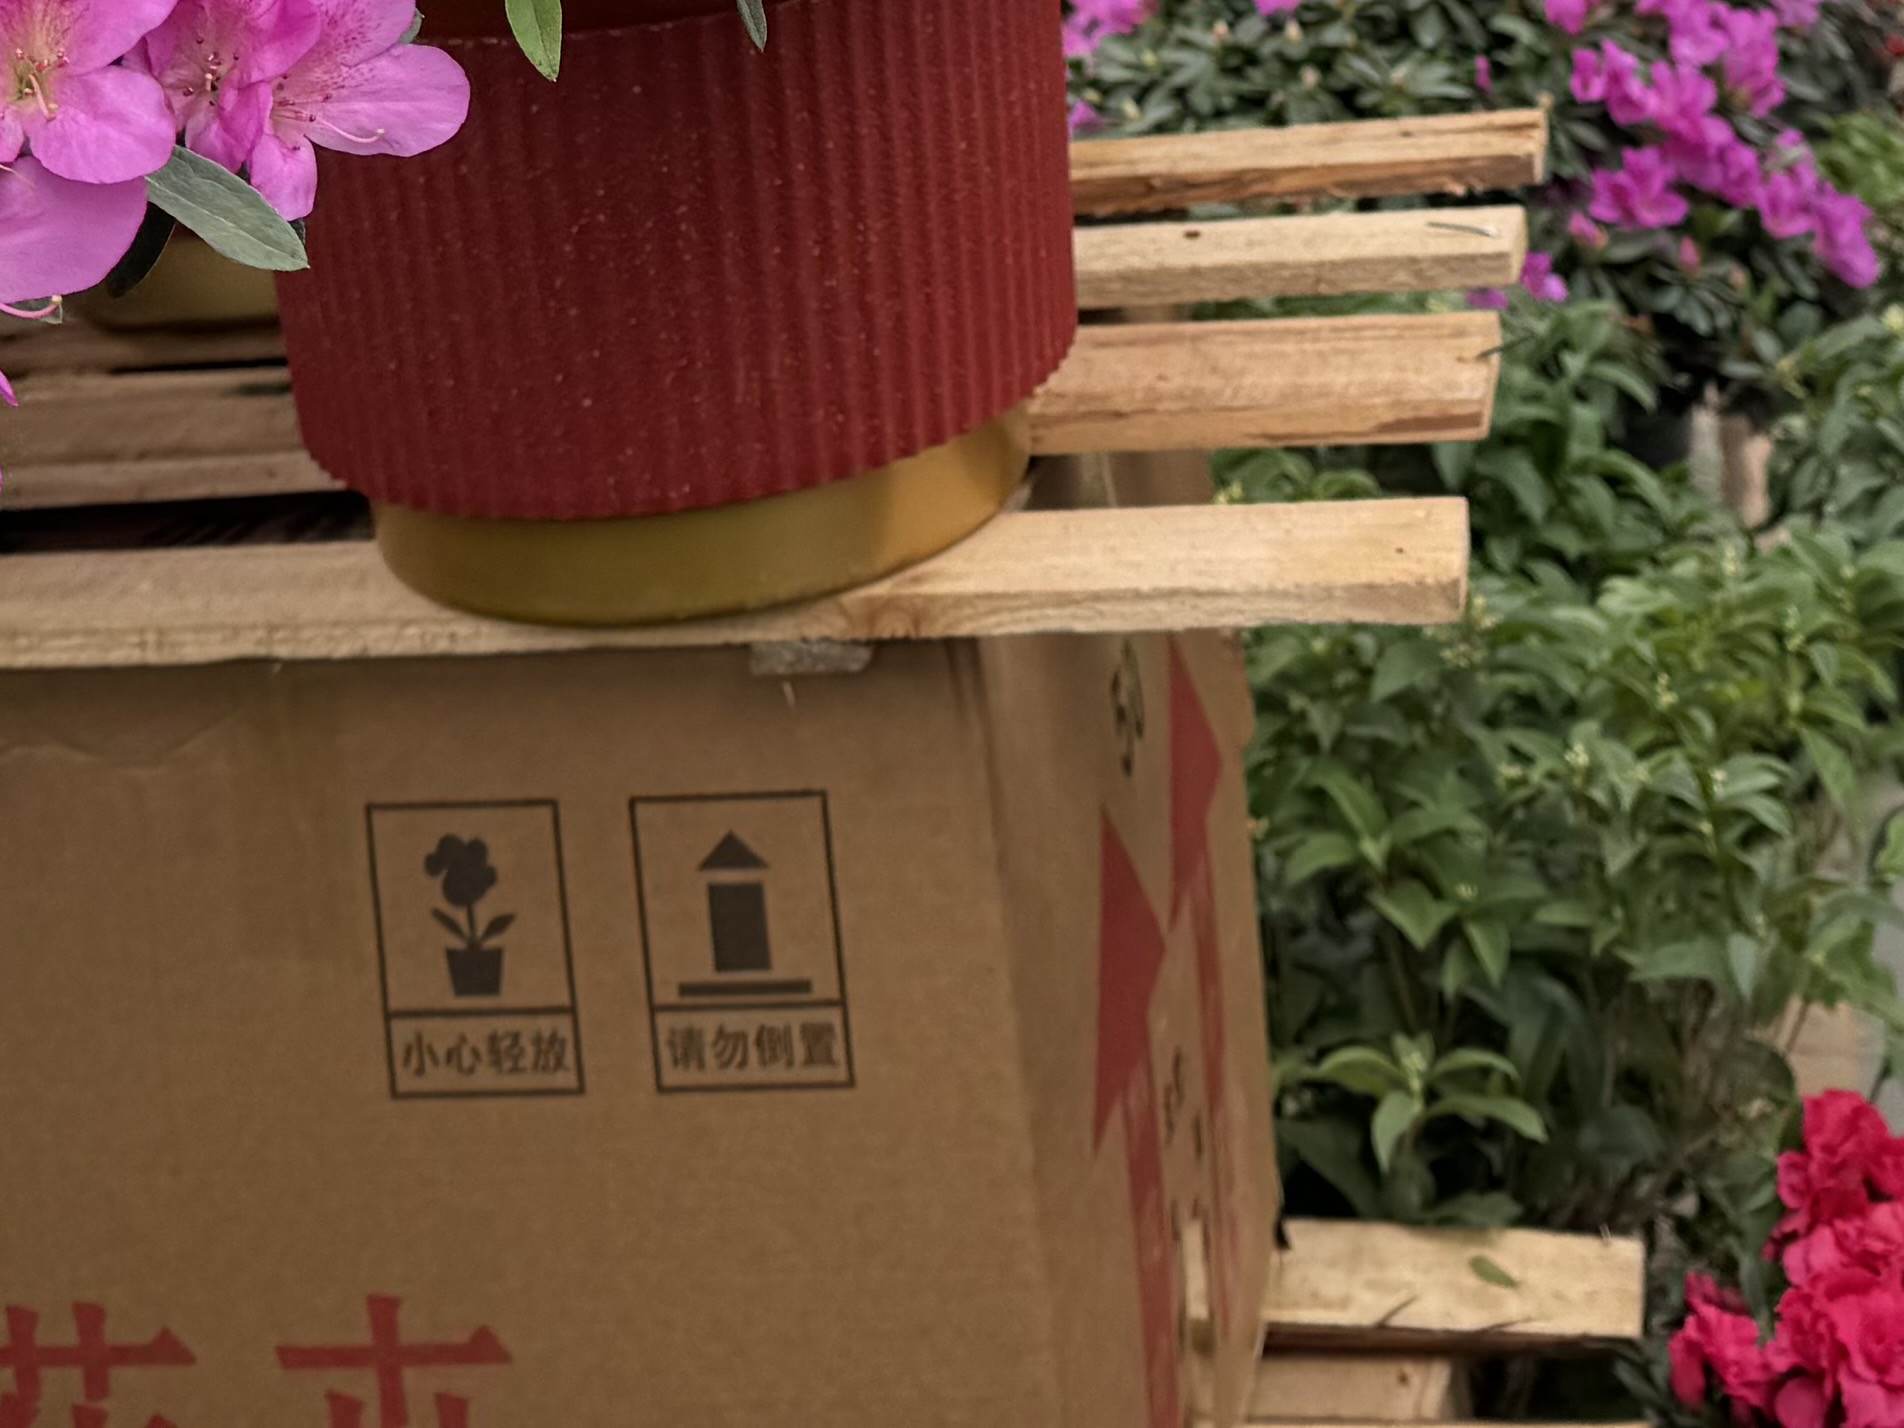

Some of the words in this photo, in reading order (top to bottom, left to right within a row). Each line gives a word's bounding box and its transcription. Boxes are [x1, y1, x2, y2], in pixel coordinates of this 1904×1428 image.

[400, 1028, 571, 1077] 小心轻放
[665, 1020, 840, 1071] 请勿倒置
